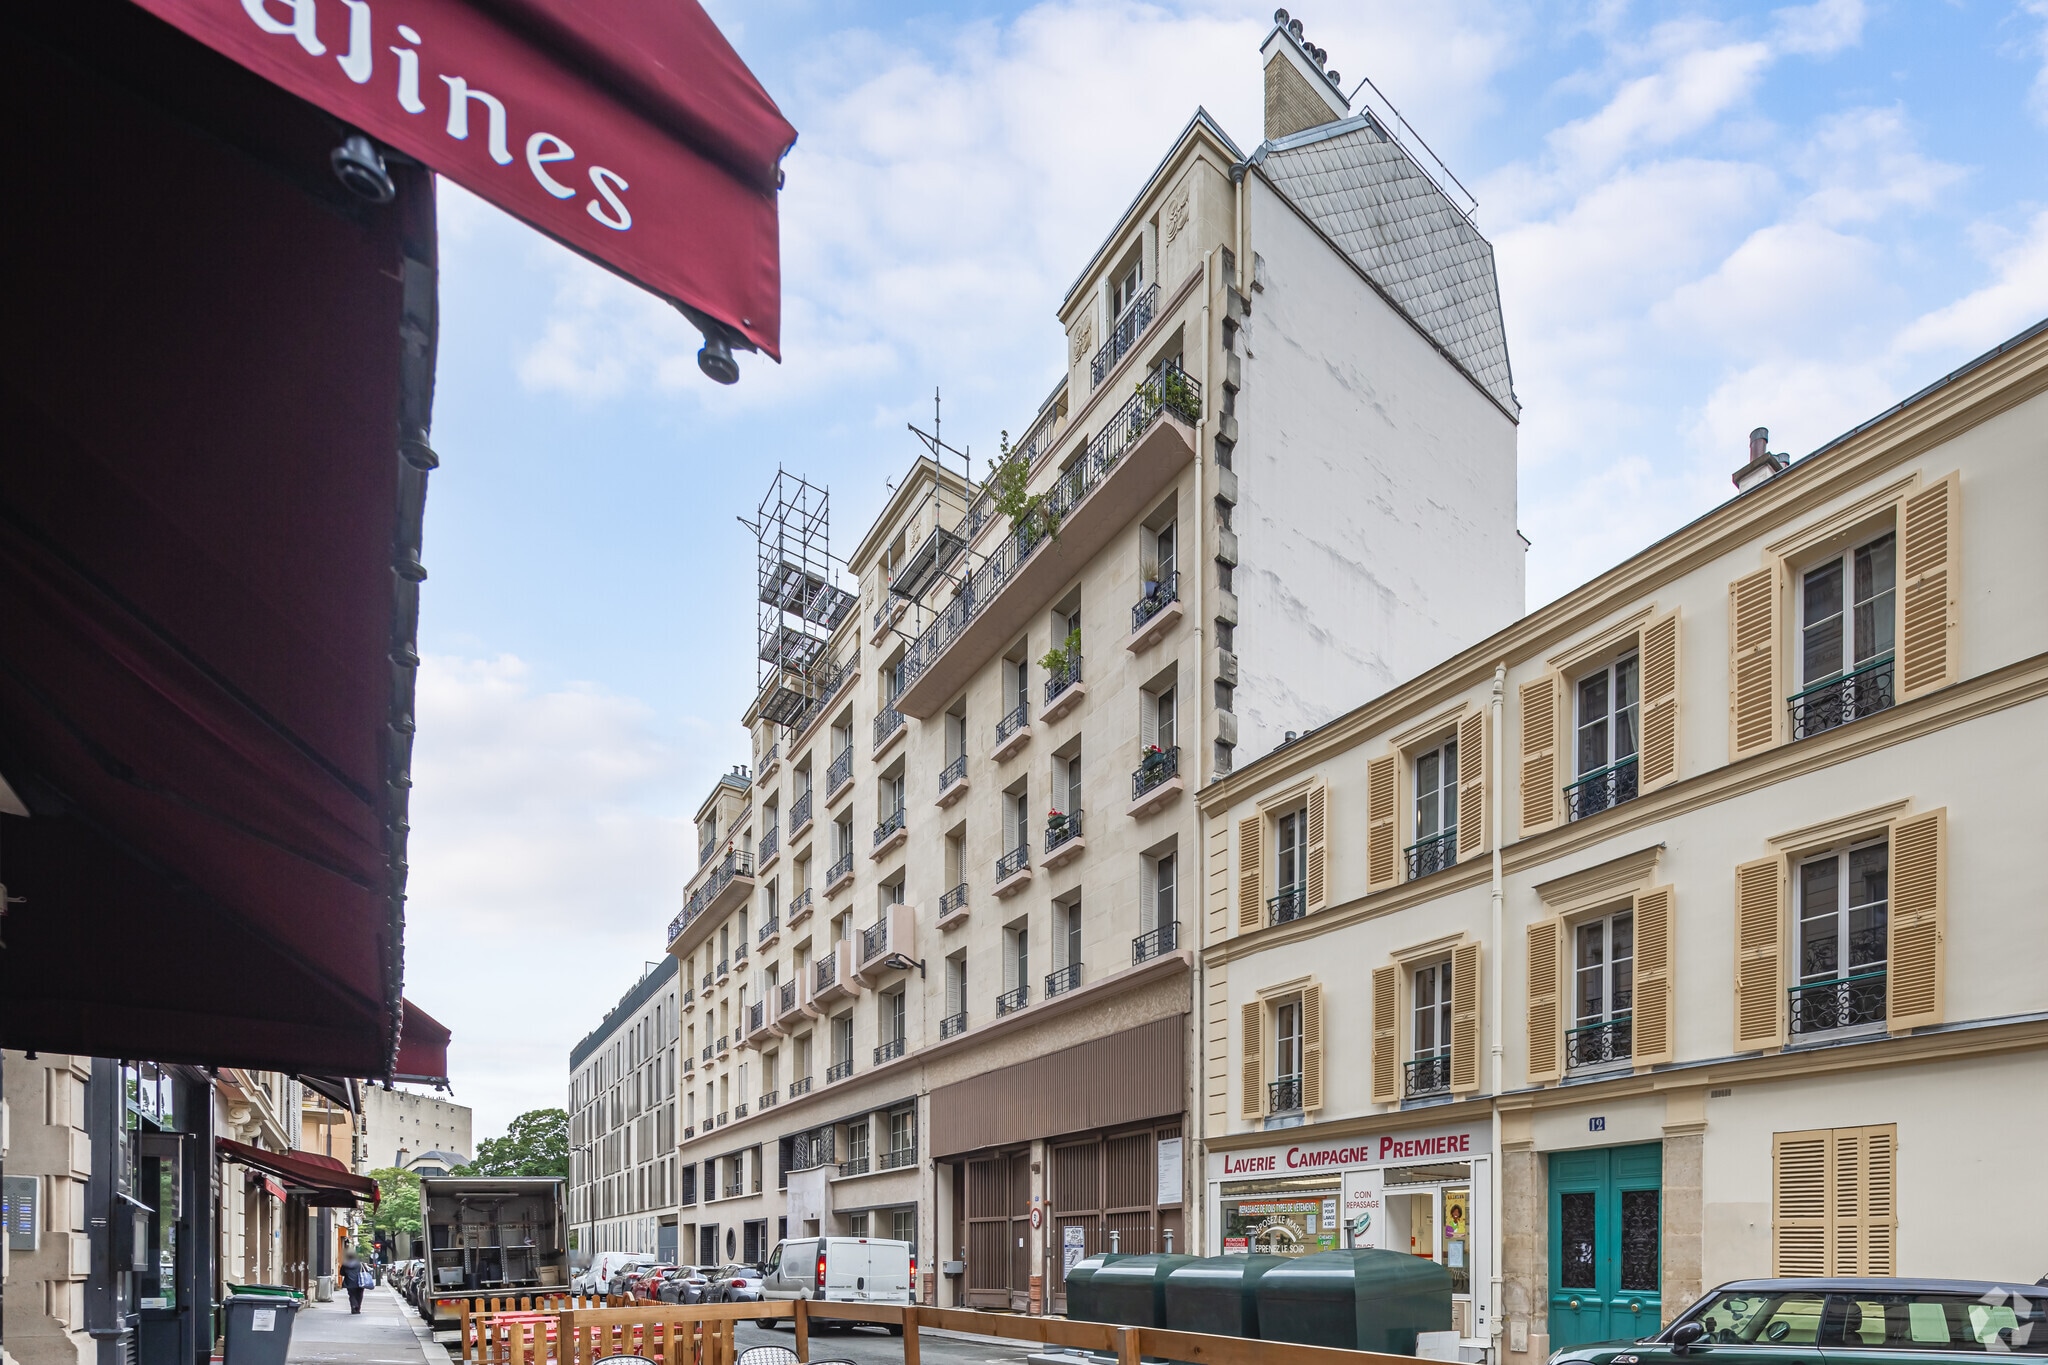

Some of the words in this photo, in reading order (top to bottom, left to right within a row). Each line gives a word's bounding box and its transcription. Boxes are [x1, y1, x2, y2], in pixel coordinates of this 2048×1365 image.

[1591, 1119, 1603, 1130] 12
[1224, 1155, 1276, 1174] LAVERIE
[1286, 1146, 1368, 1169] CAMPAGNE
[1379, 1134, 1470, 1160] PREMIERE
[1354, 1191, 1372, 1199] COIN
[1346, 1200, 1380, 1209] REPASSAGE
[1278, 1215, 1285, 1224] LE
[1286, 1218, 1304, 1239] MATIN
[1281, 1244, 1288, 1253] LE
[1289, 1244, 1305, 1253] SOIR
